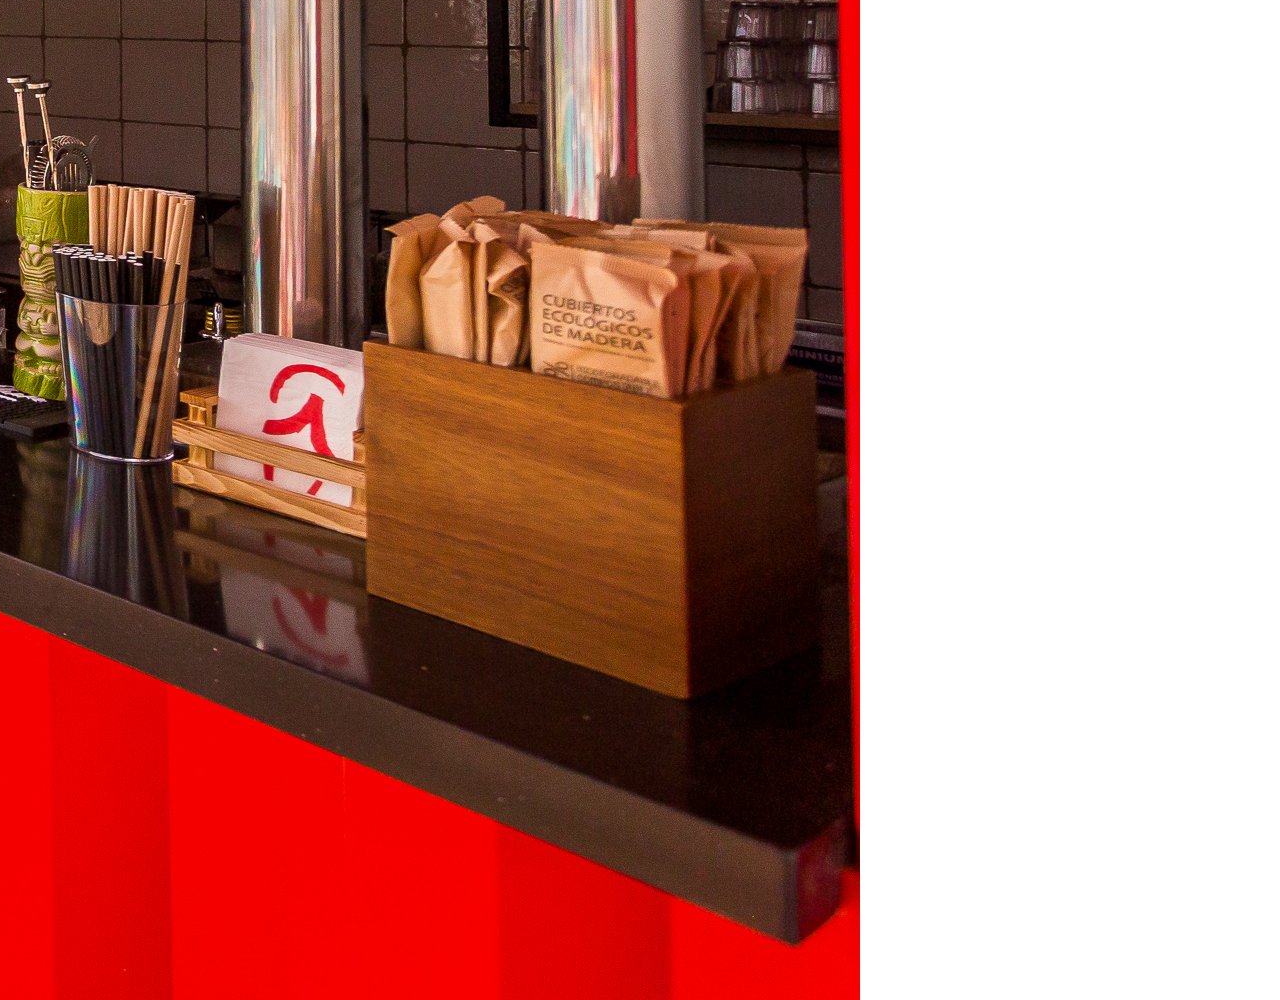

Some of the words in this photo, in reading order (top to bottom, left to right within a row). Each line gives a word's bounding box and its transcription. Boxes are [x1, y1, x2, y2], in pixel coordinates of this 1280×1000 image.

[542, 293, 637, 322] CUBIERTOS
[542, 322, 563, 337] DE
[567, 328, 647, 353] MADERA
